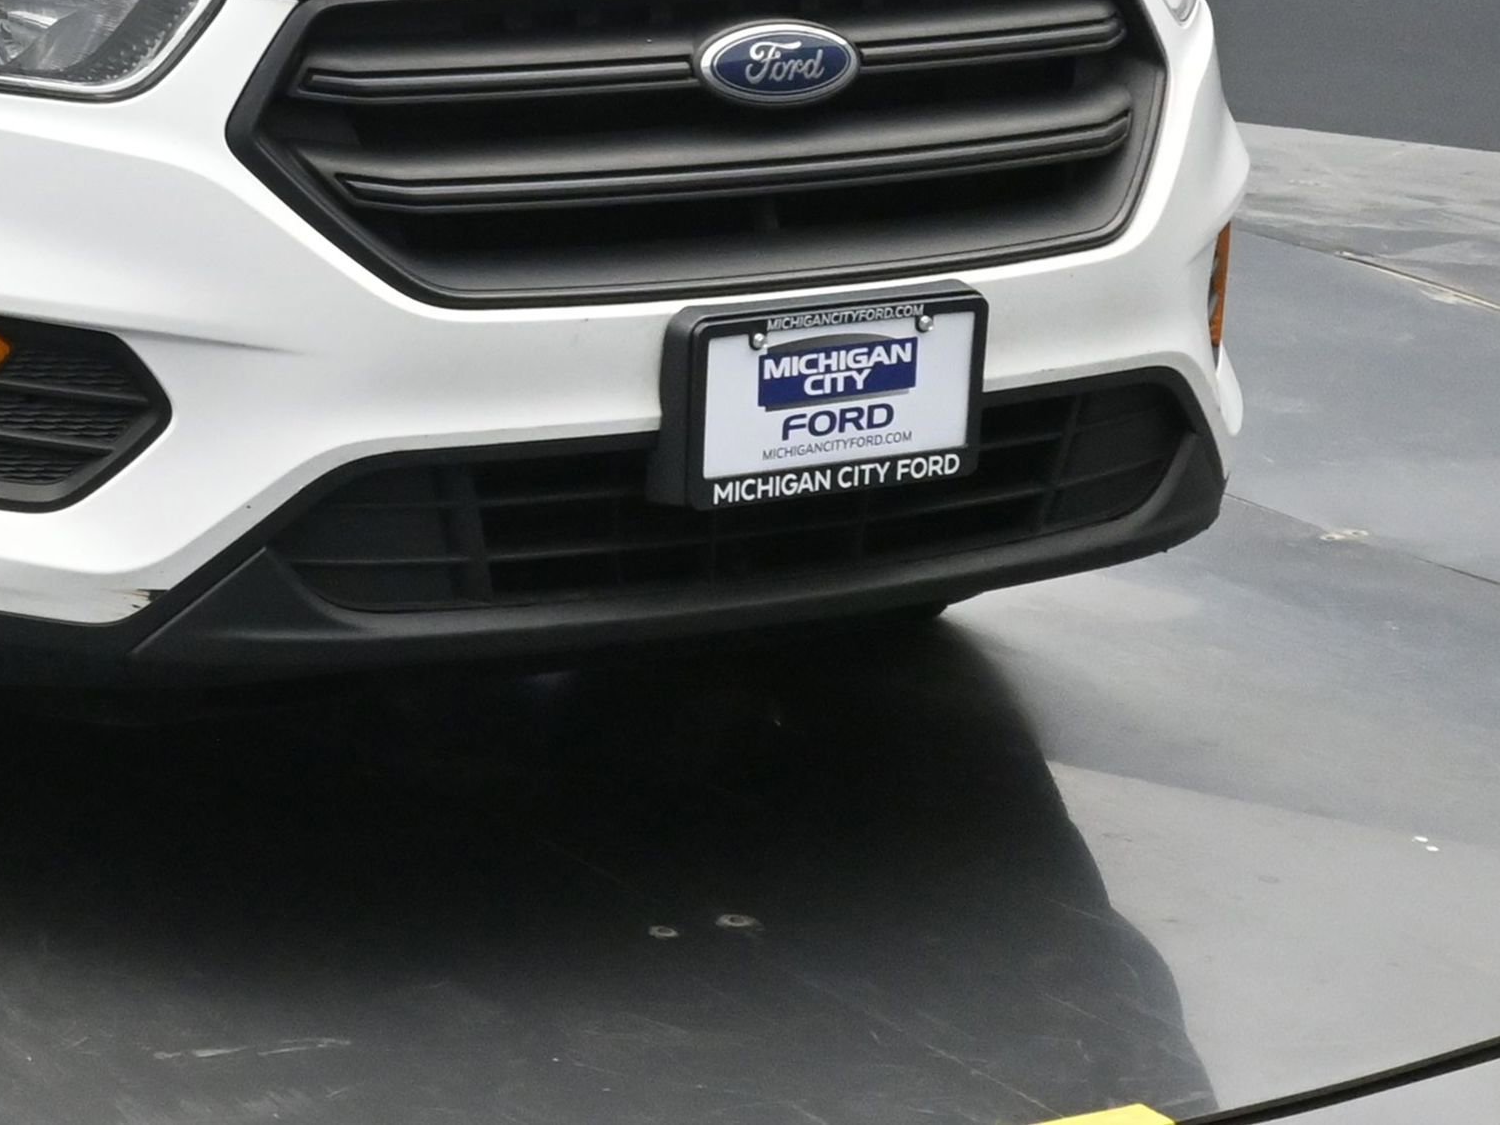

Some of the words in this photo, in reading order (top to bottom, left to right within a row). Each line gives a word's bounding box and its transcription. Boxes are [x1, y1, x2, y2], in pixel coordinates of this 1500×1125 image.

[745, 41, 825, 85] Ford
[766, 304, 924, 331] MICHIGANCITYFORD.COM
[763, 342, 912, 380] MICHIGAN
[803, 369, 871, 396] CITY
[781, 403, 895, 441] FORD
[762, 431, 913, 461] MICHIGANCITYFORD.COM
[713, 469, 831, 505] MICHIGAN
[837, 462, 890, 489] CITY
[896, 453, 960, 480] FORD
